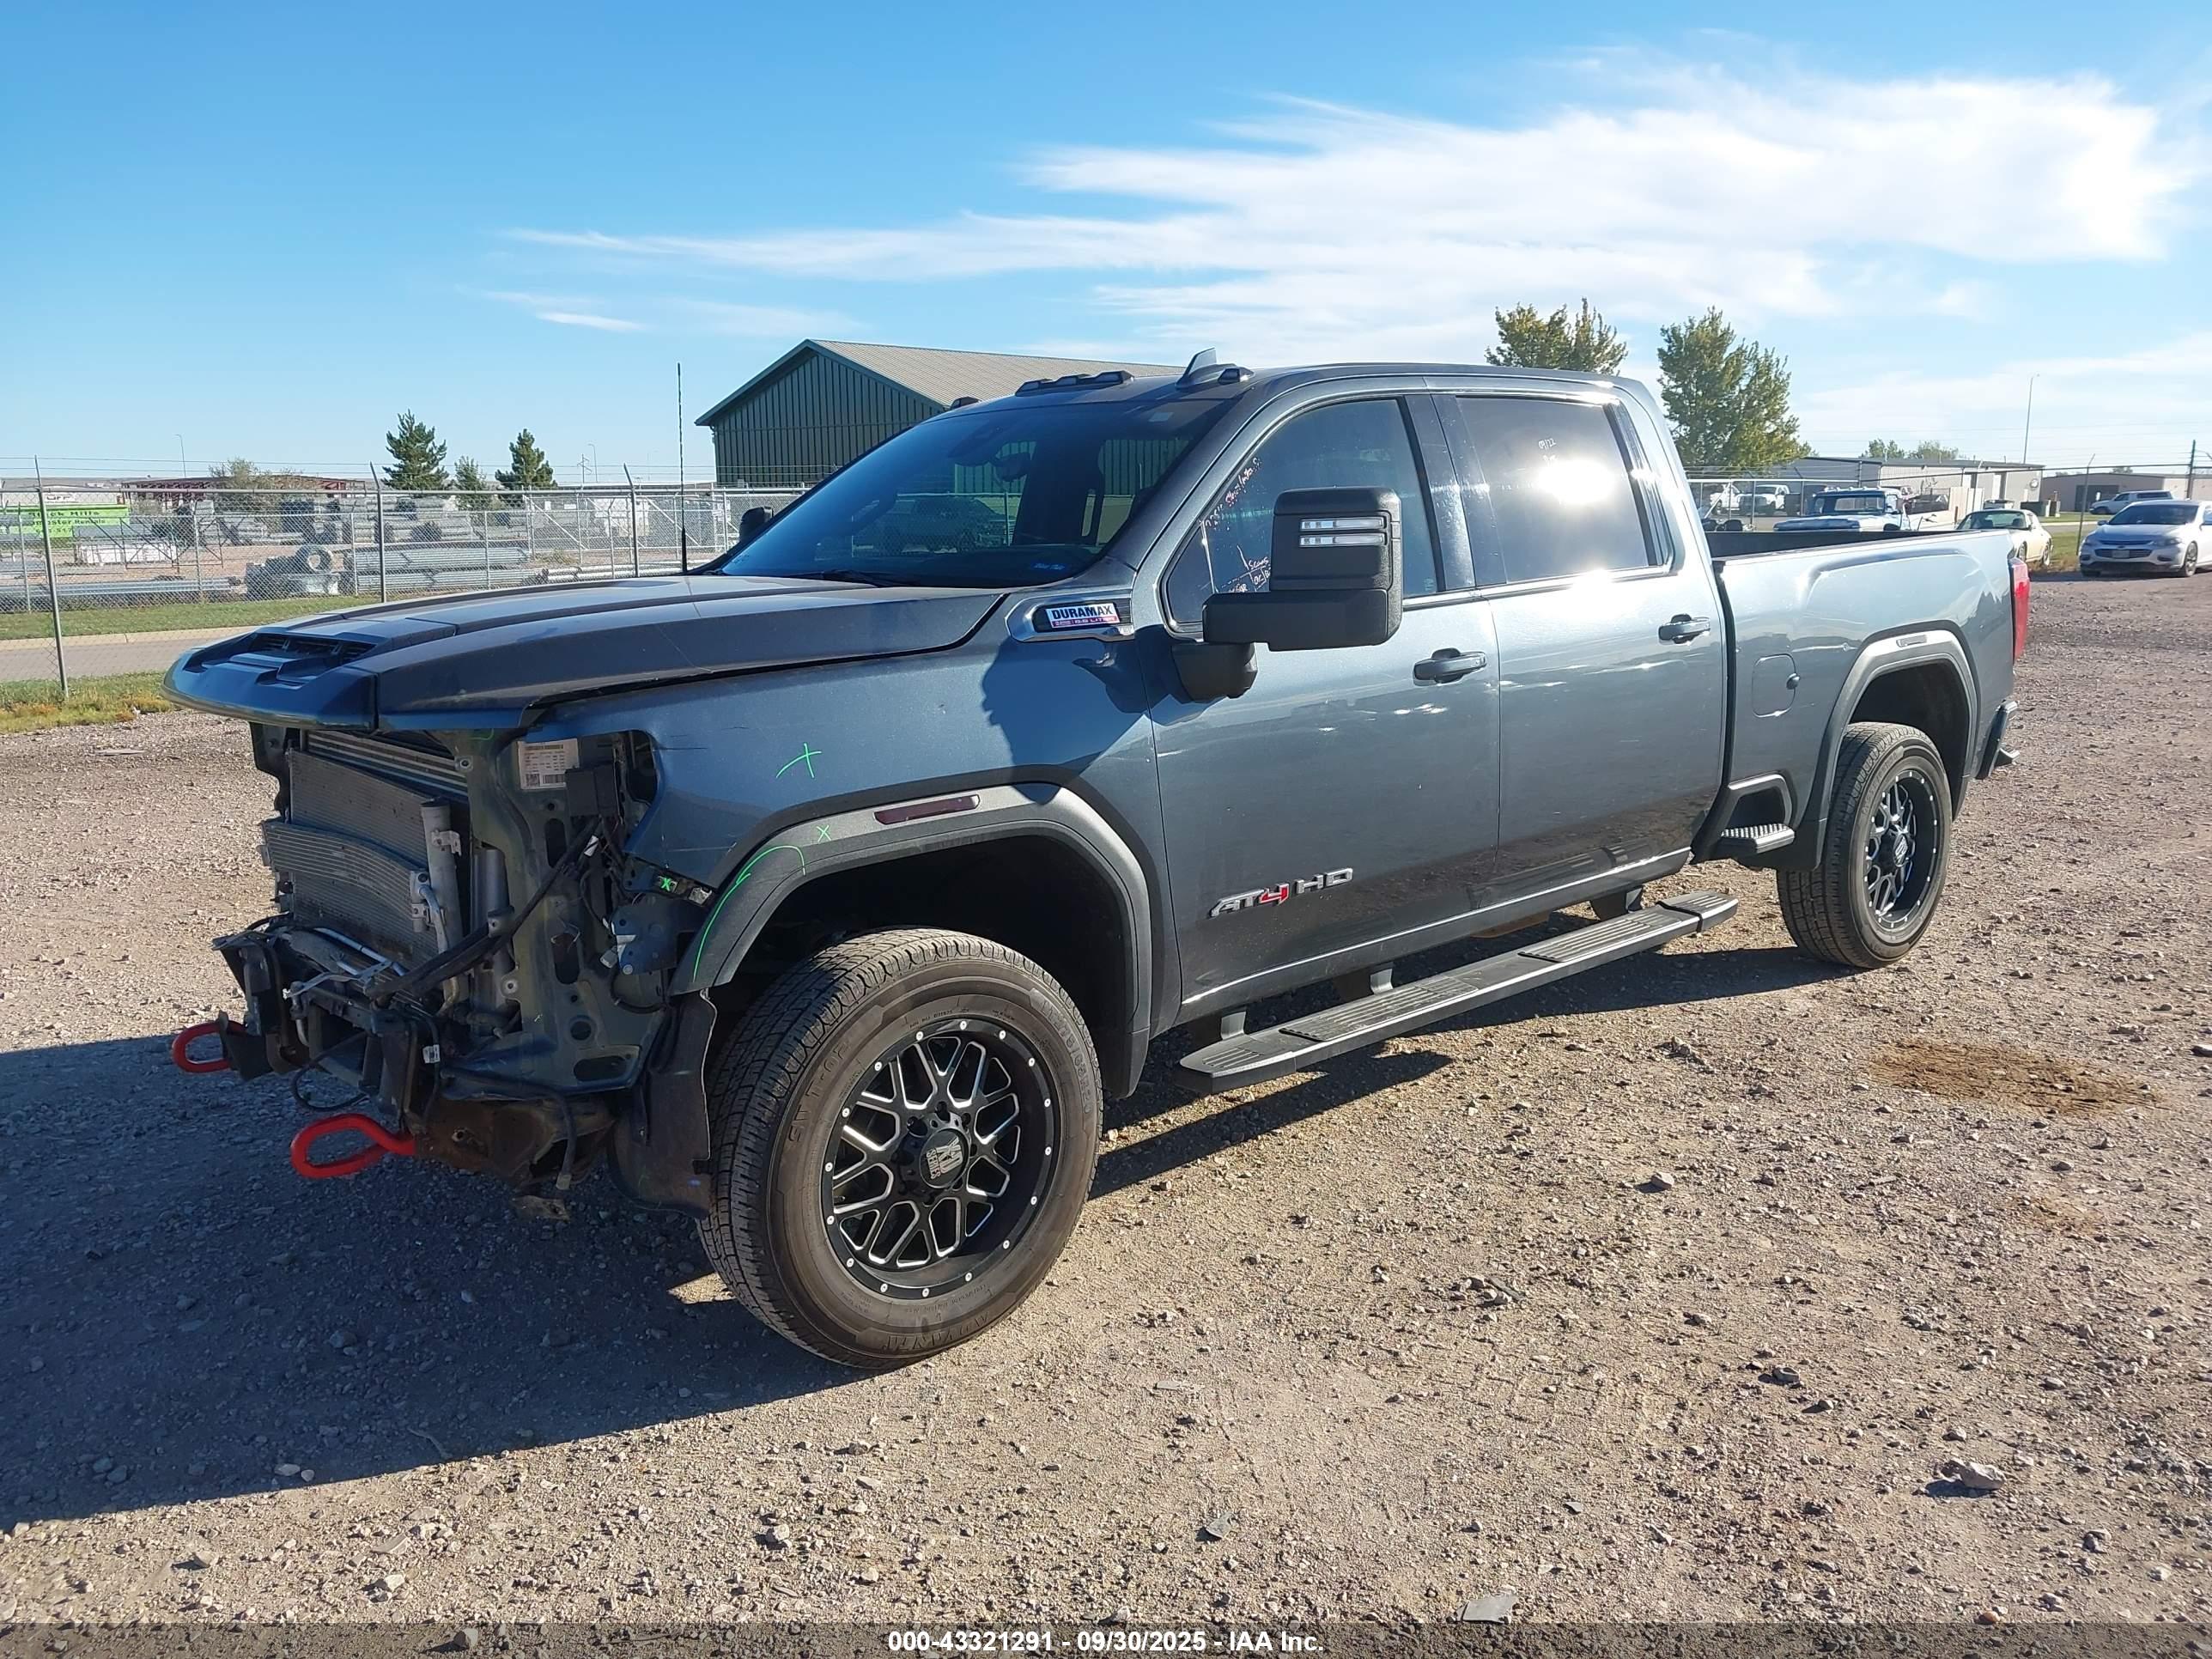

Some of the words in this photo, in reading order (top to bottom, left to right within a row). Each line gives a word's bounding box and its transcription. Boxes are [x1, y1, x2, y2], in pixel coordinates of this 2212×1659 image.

[1050, 605, 1114, 620] DURAMAX
[1207, 882, 1290, 919] AT4
[1295, 867, 1354, 896] HD
[926, 1148, 942, 1180] SERIES
[935, 1135, 963, 1174] XD
